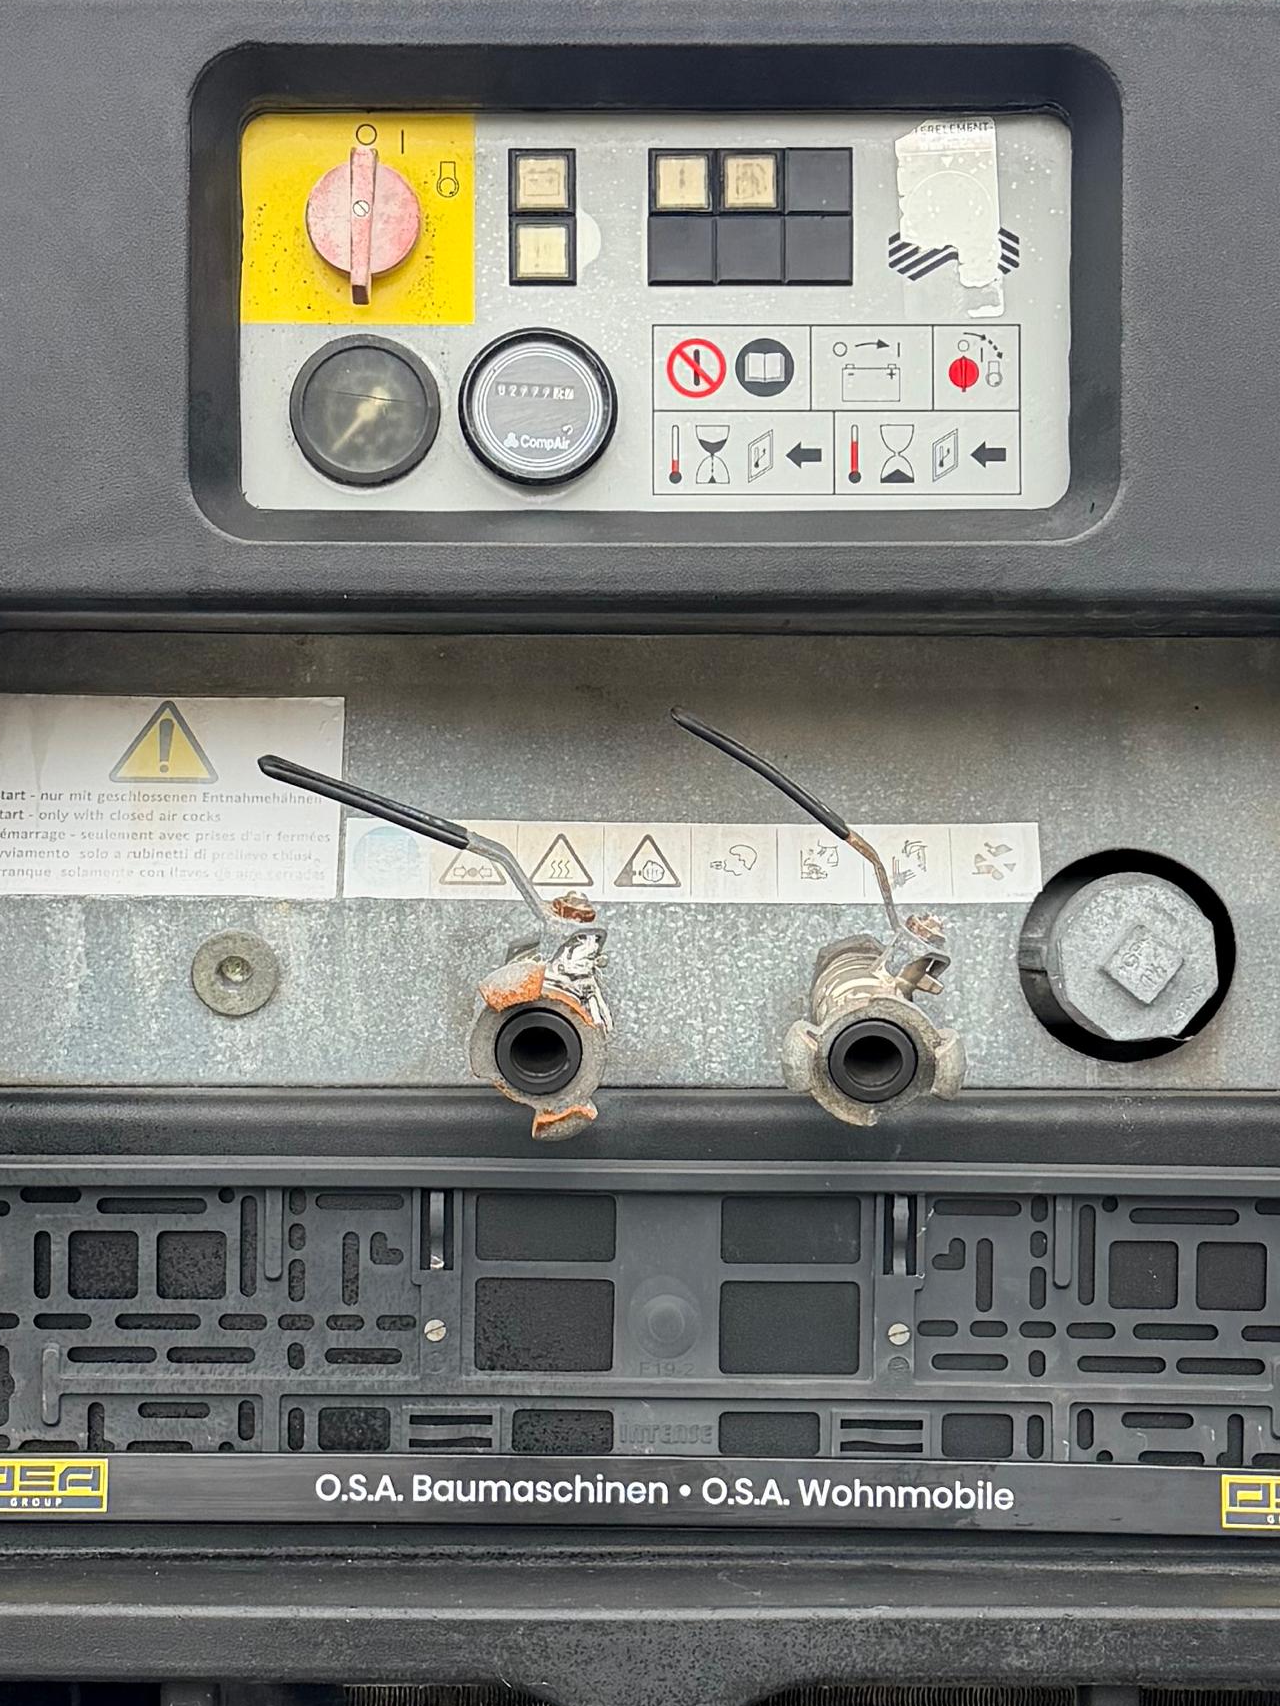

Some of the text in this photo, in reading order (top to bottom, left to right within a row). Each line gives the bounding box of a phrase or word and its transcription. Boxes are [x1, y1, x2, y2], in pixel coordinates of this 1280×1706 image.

[520, 434, 571, 451] CompAir
[40, 791, 63, 801] nur
[69, 790, 92, 802] mit
[97, 790, 197, 804] geschlossenen
[38, 809, 69, 823] only
[73, 809, 104, 821] with
[109, 809, 154, 822] closed
[158, 811, 178, 822] air
[182, 810, 222, 822] cocks
[80, 829, 154, 841] seulement
[159, 830, 191, 841] avec
[126, 847, 188, 860] rubinetti
[193, 848, 207, 860] di
[315, 1473, 403, 1505] O.S.A.
[413, 1473, 668, 1506] Baumaschinen
[702, 1477, 790, 1508] O.S.A.
[797, 1478, 1015, 1511] Wohnmobile
[9, 1497, 63, 1508] GROUP
